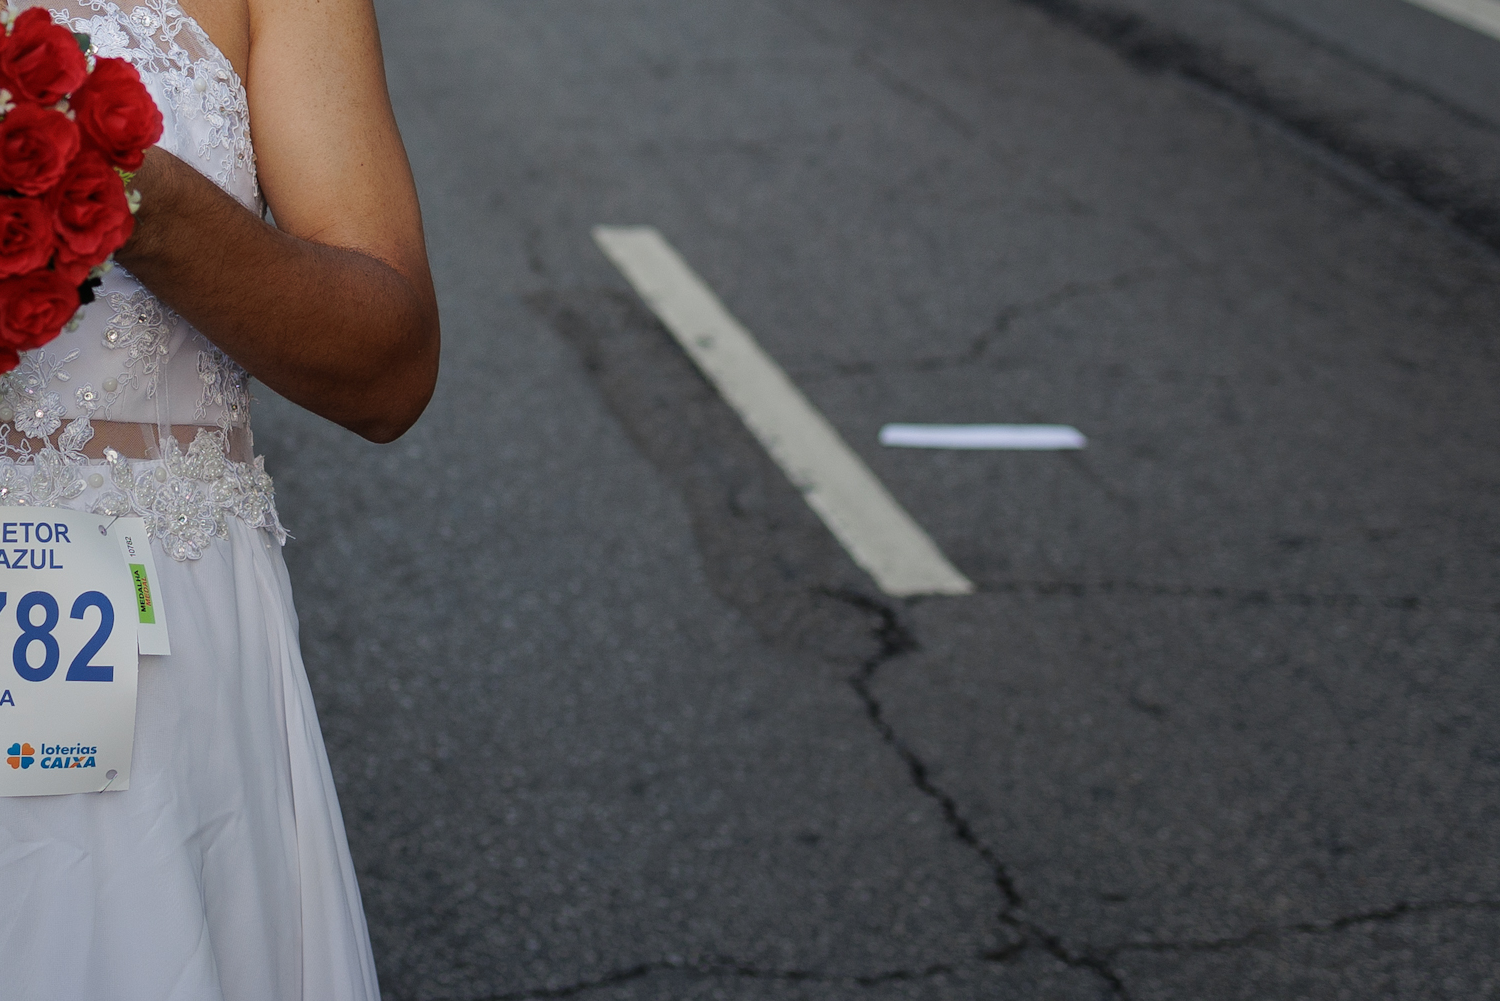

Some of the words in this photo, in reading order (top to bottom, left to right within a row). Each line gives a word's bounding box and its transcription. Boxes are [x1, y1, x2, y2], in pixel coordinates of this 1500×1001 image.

[124, 536, 136, 557] 10782
[133, 570, 147, 613] MEDALHA
[141, 576, 152, 607] MEDAL
[41, 742, 98, 755] loterias
[40, 756, 97, 769] CAIXA
